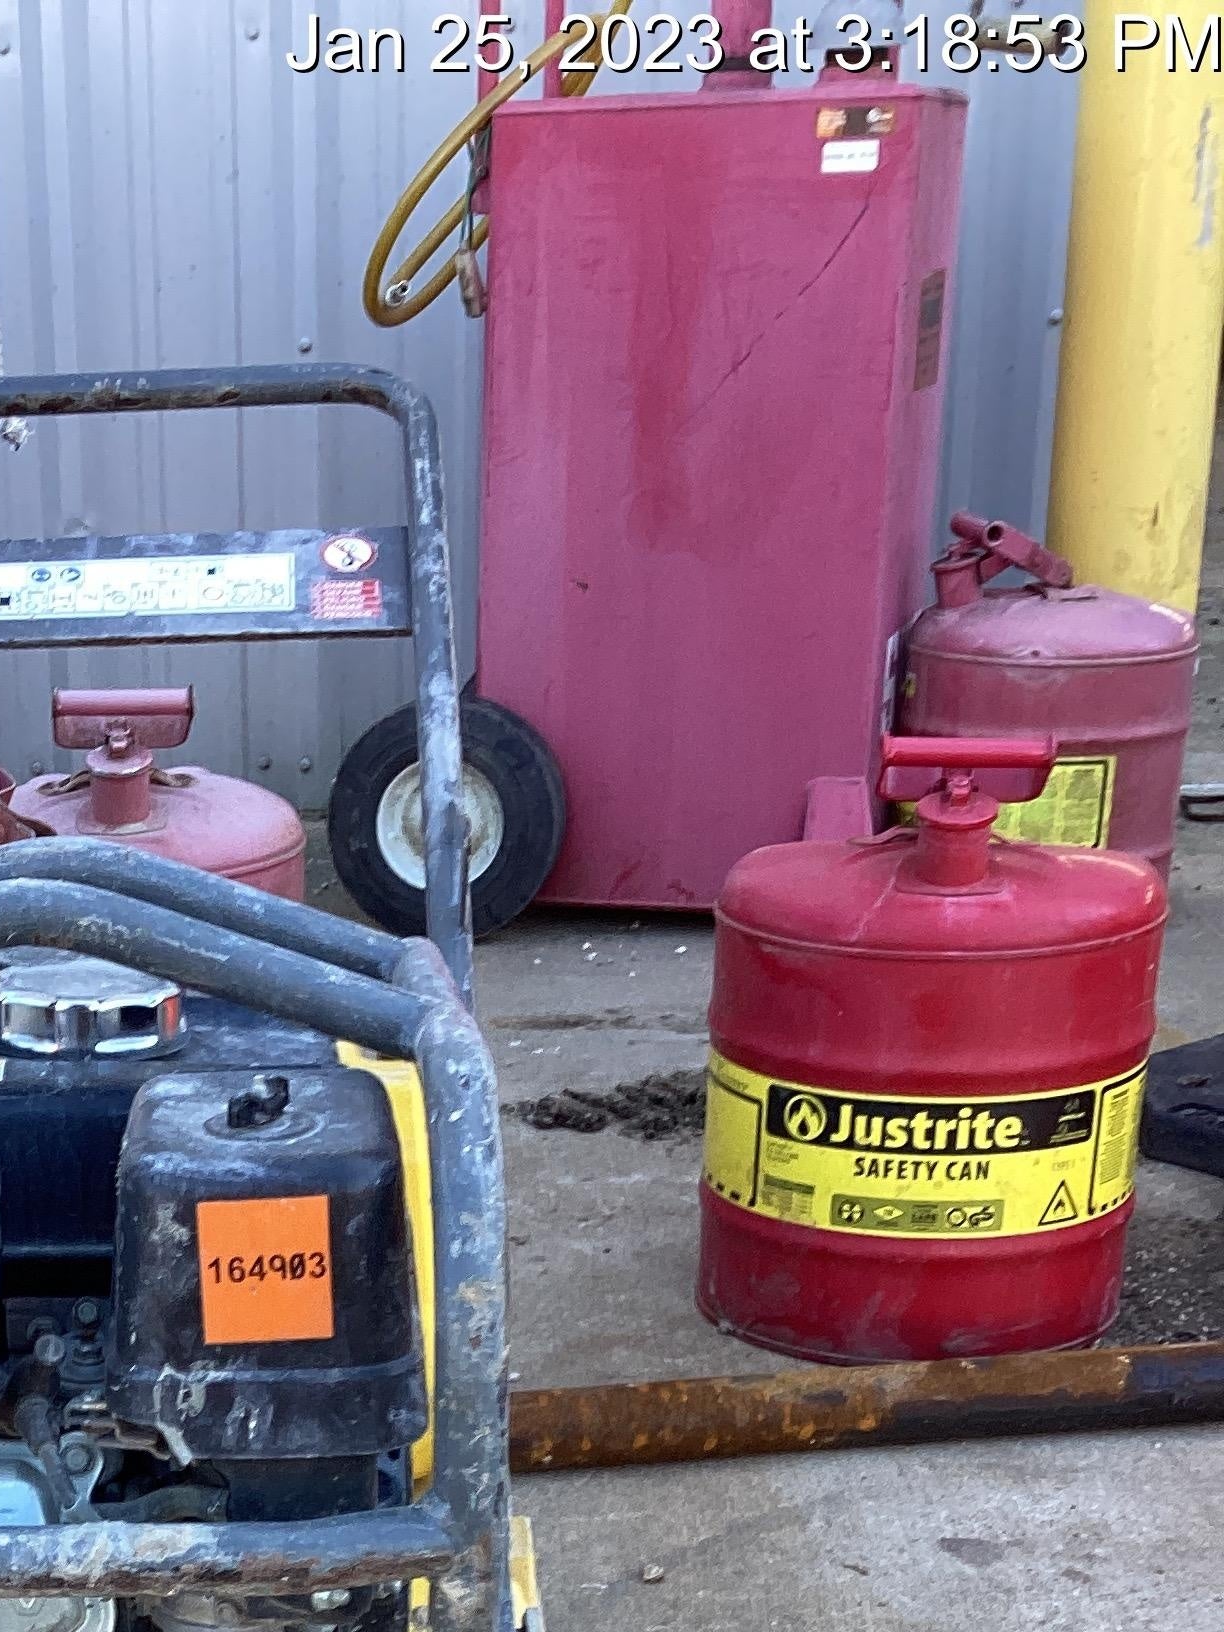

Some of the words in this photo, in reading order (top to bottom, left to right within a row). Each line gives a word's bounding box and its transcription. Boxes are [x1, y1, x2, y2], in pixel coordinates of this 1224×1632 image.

[829, 1103, 1023, 1151] Justrite
[852, 1156, 938, 1181] SAFETY
[944, 1159, 992, 1181] CAN
[207, 1251, 327, 1284] 164903
